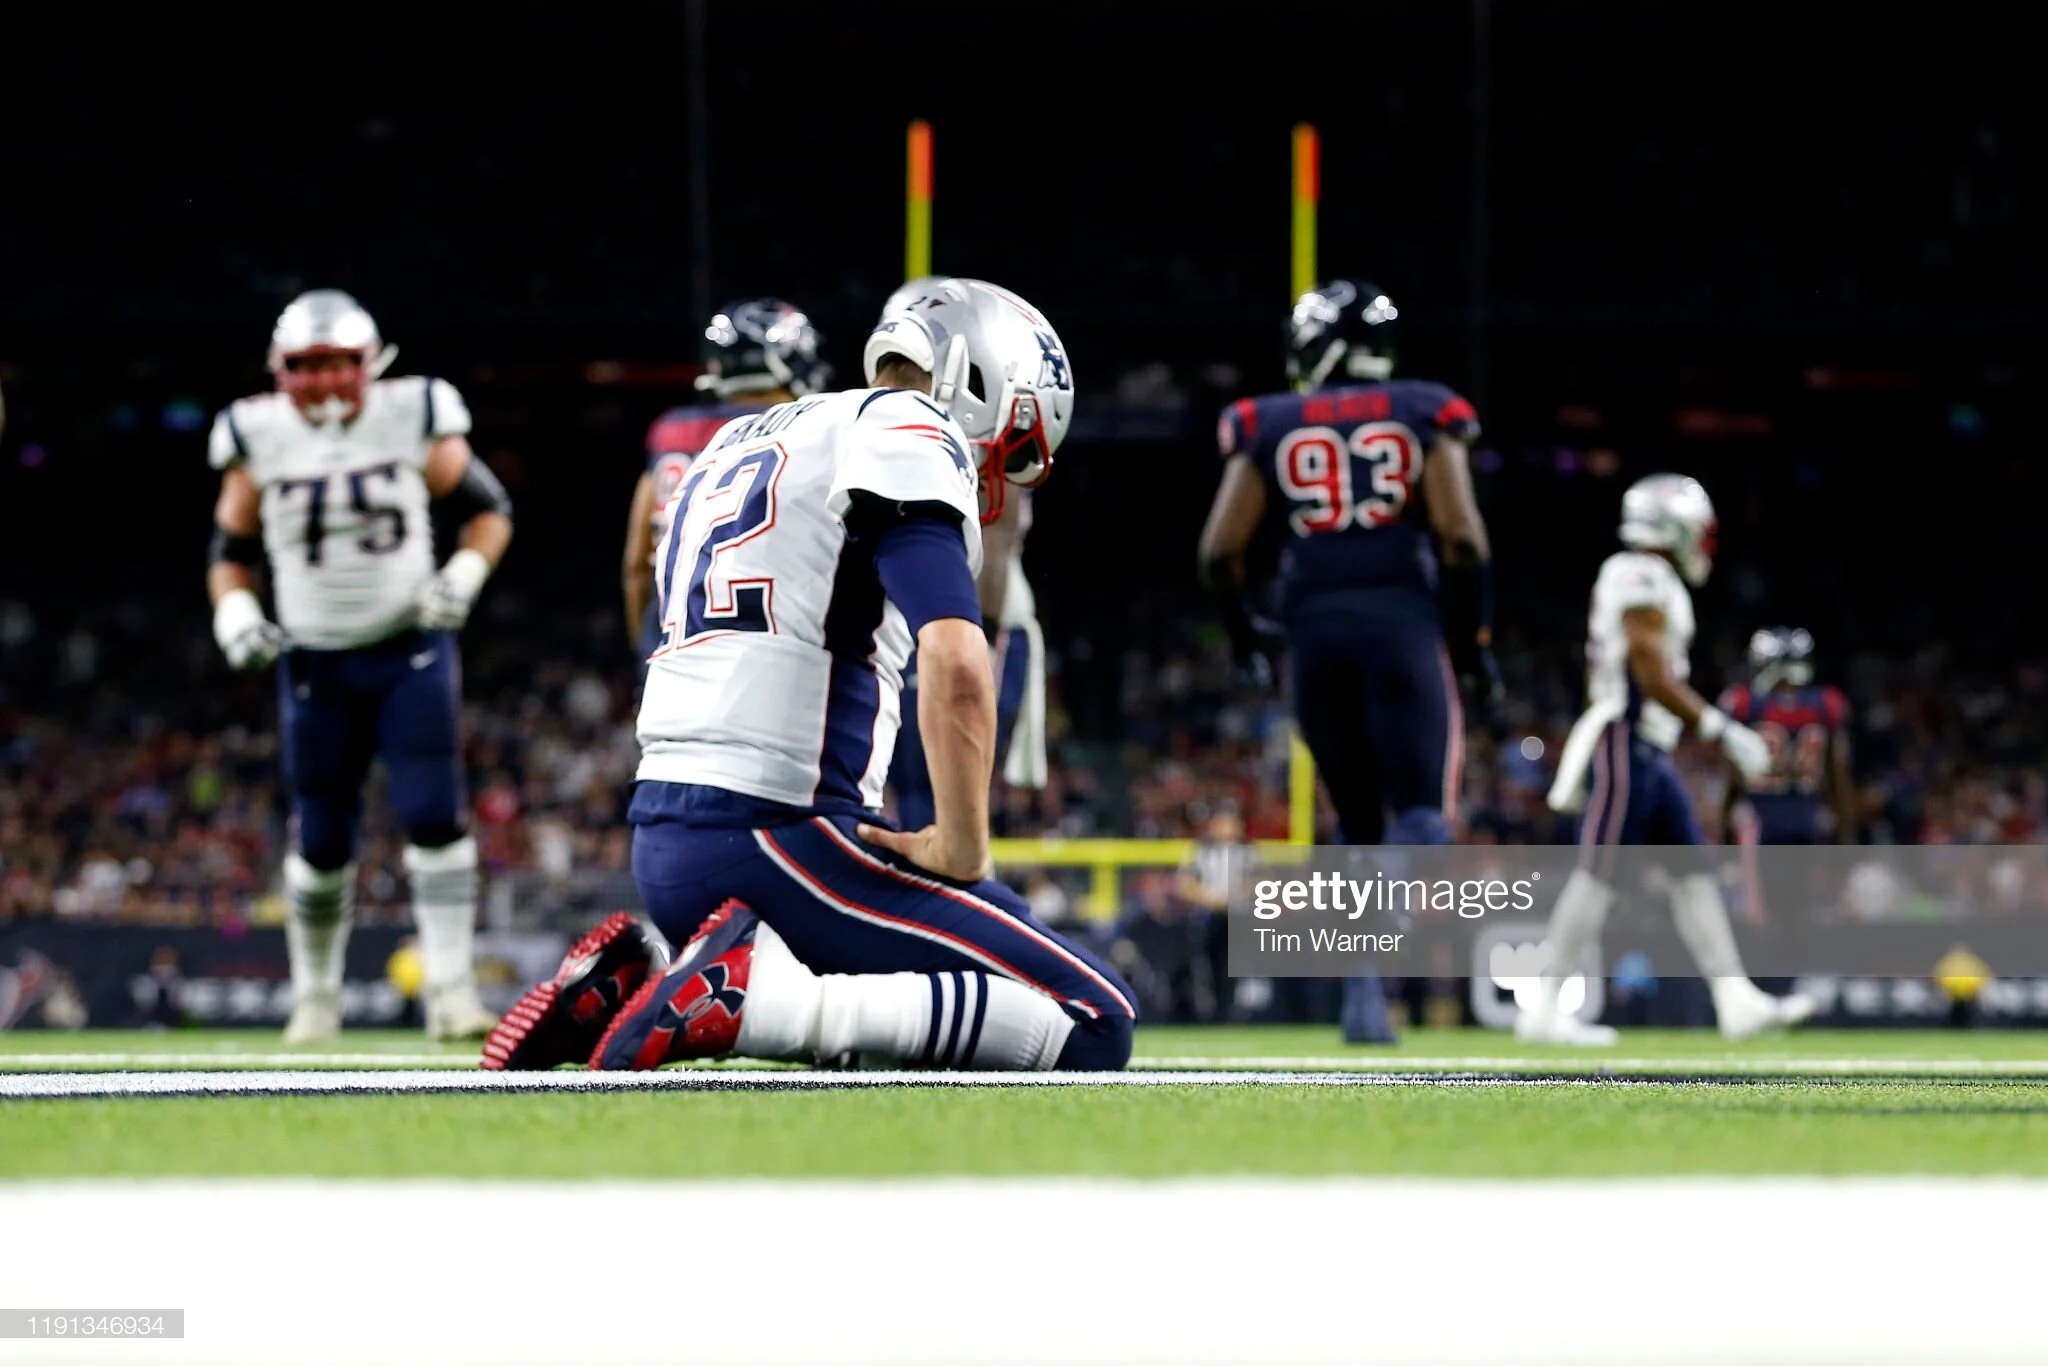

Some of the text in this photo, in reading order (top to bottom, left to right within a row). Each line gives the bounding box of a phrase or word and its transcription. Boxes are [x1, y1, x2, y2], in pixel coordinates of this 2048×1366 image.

[278, 460, 408, 568] 75
[1275, 420, 1424, 538] 93
[650, 441, 788, 660] 12
